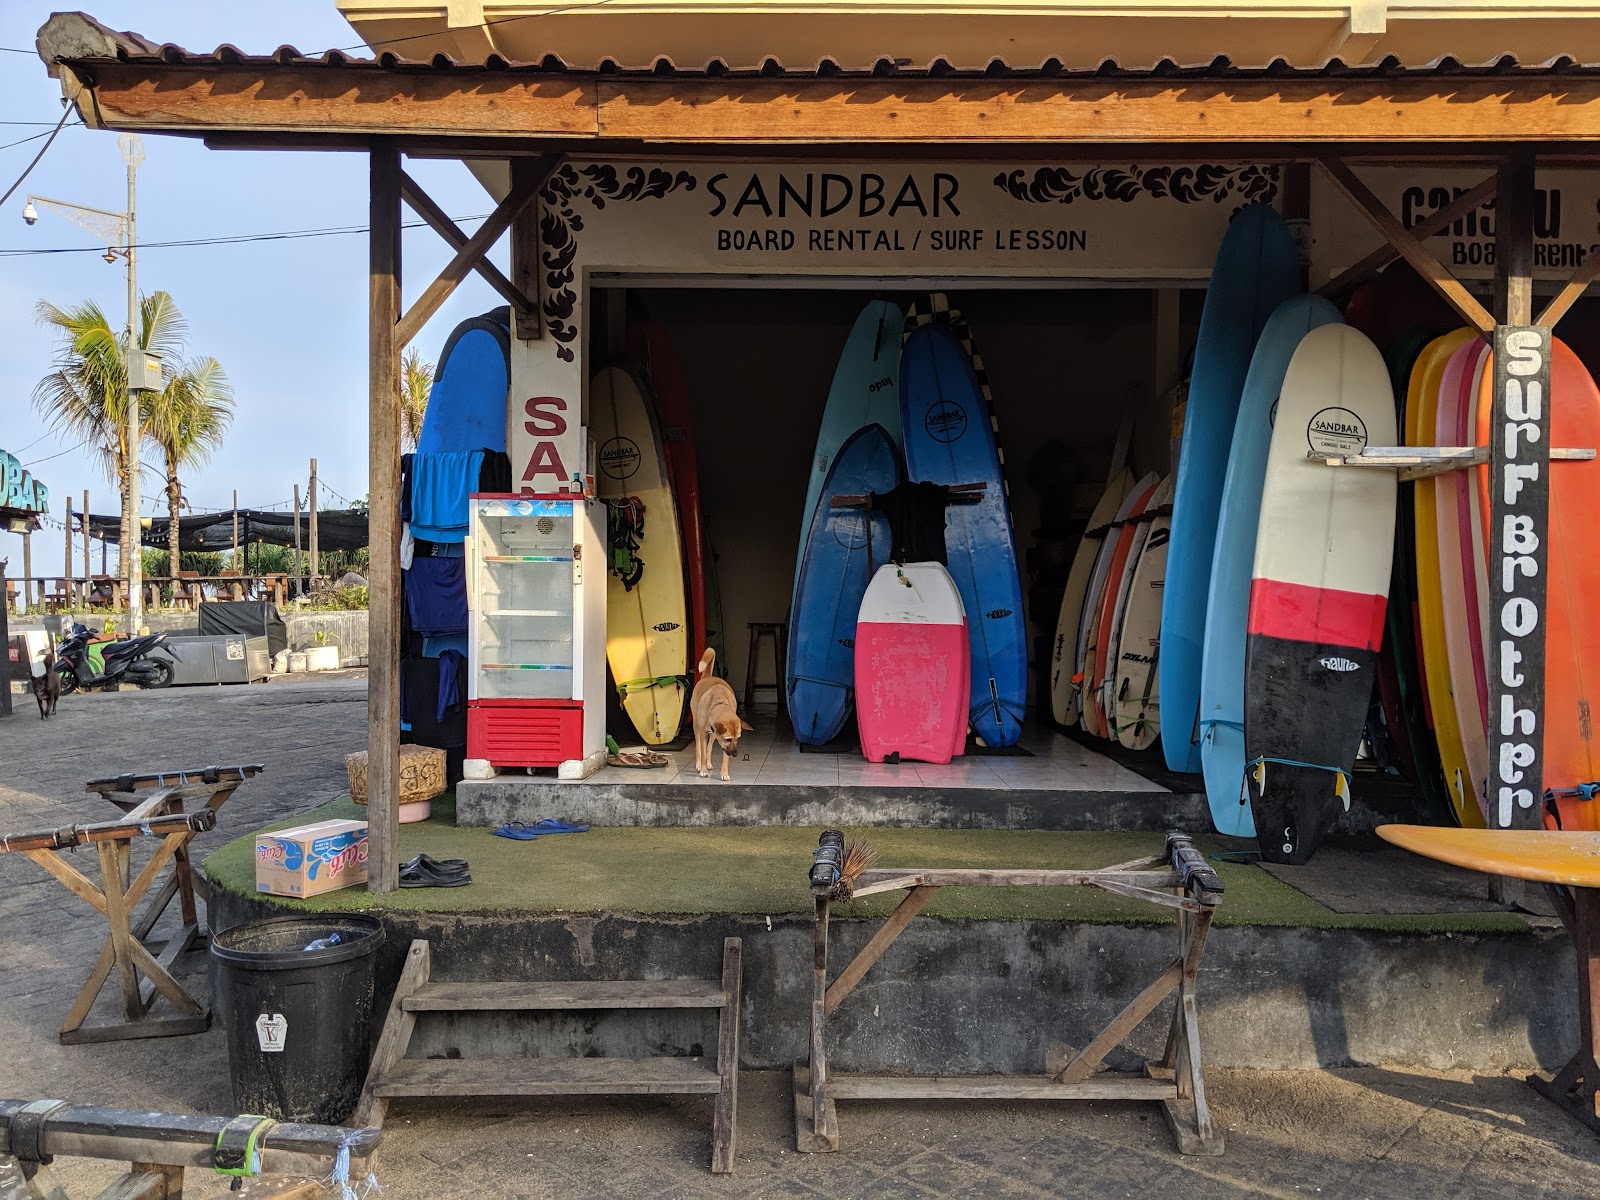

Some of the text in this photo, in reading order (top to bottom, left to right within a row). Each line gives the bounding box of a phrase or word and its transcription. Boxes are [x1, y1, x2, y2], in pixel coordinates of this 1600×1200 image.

[706, 173, 961, 218] SANDBAR
[1402, 186, 1560, 239] Canu
[717, 230, 795, 251] BOARD
[809, 229, 905, 251] RENTAL
[930, 229, 984, 251] SURF
[995, 230, 1087, 251] LESSON
[520, 396, 570, 494] SA
[1315, 420, 1359, 434] SANDBAR
